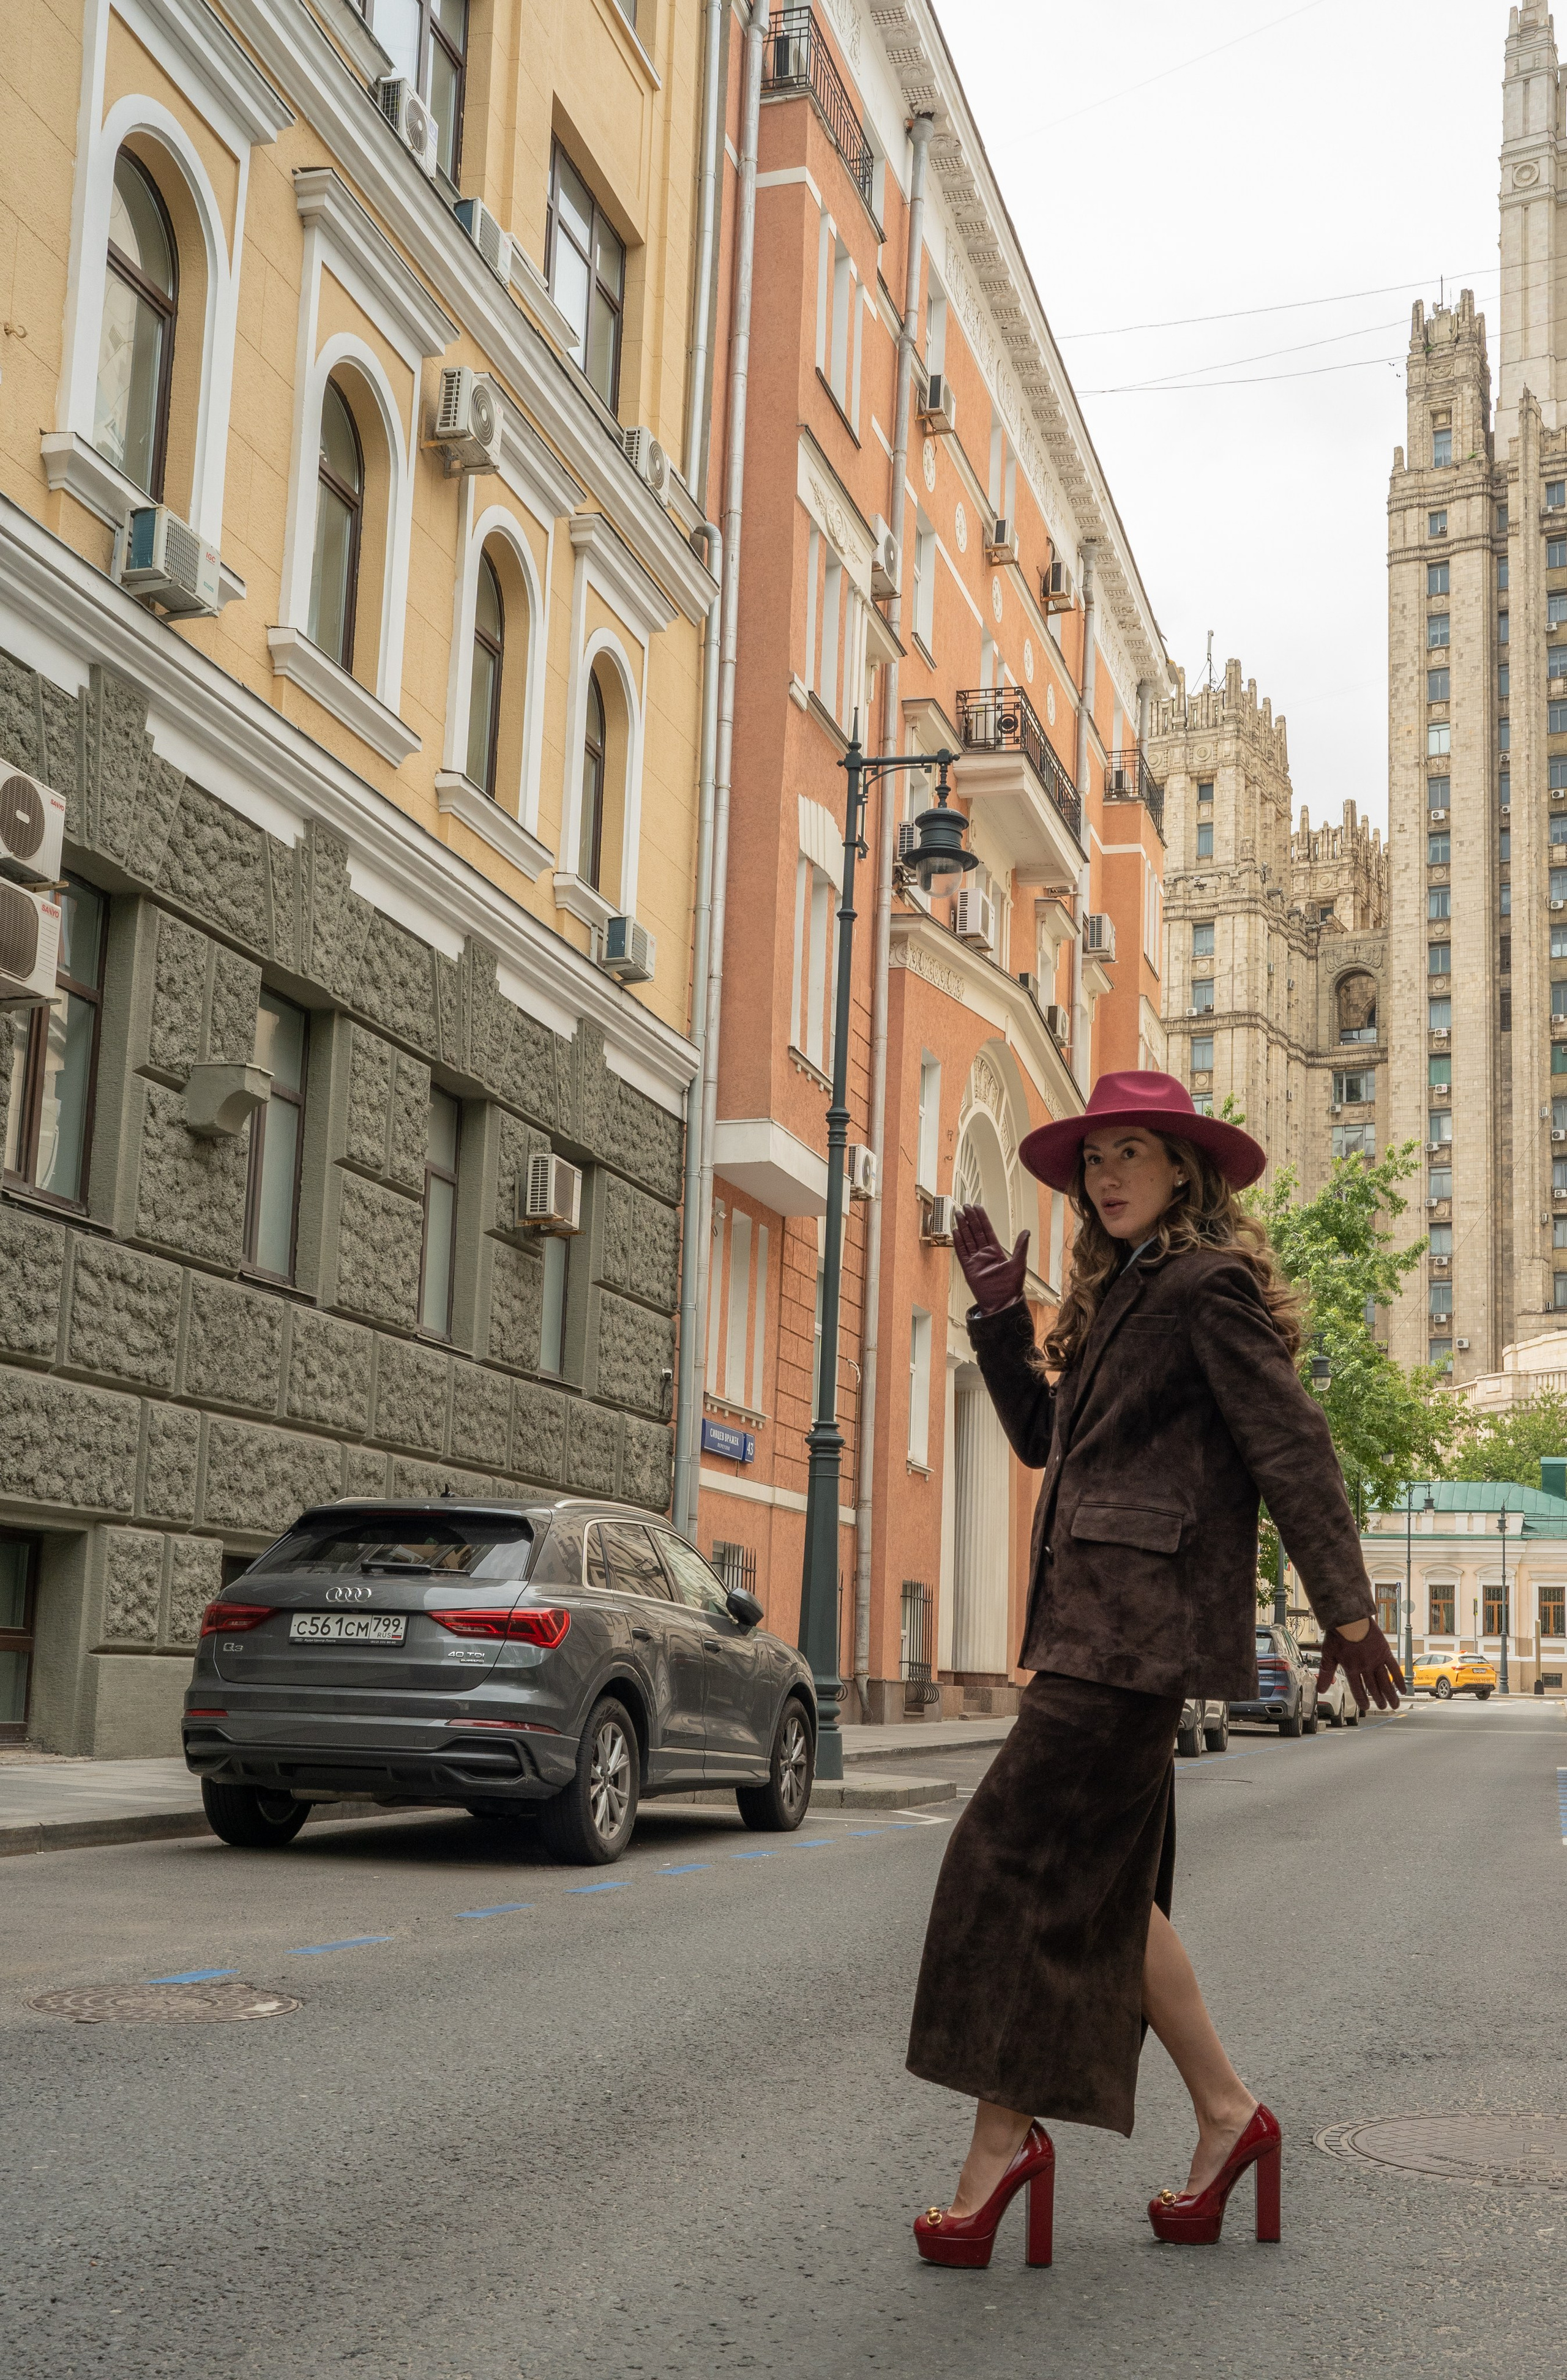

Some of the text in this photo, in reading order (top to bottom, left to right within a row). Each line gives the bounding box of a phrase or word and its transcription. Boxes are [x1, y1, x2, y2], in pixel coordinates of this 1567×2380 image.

[206, 552, 216, 563] IGC
[50, 799, 65, 811] SANYO
[41, 904, 59, 918] SANYO
[710, 1428, 739, 1446] СИВЦЕВ ВРАЖЕК
[747, 1442, 754, 1456] 43
[373, 1617, 402, 1633] 799
[223, 1643, 243, 1652] Q3
